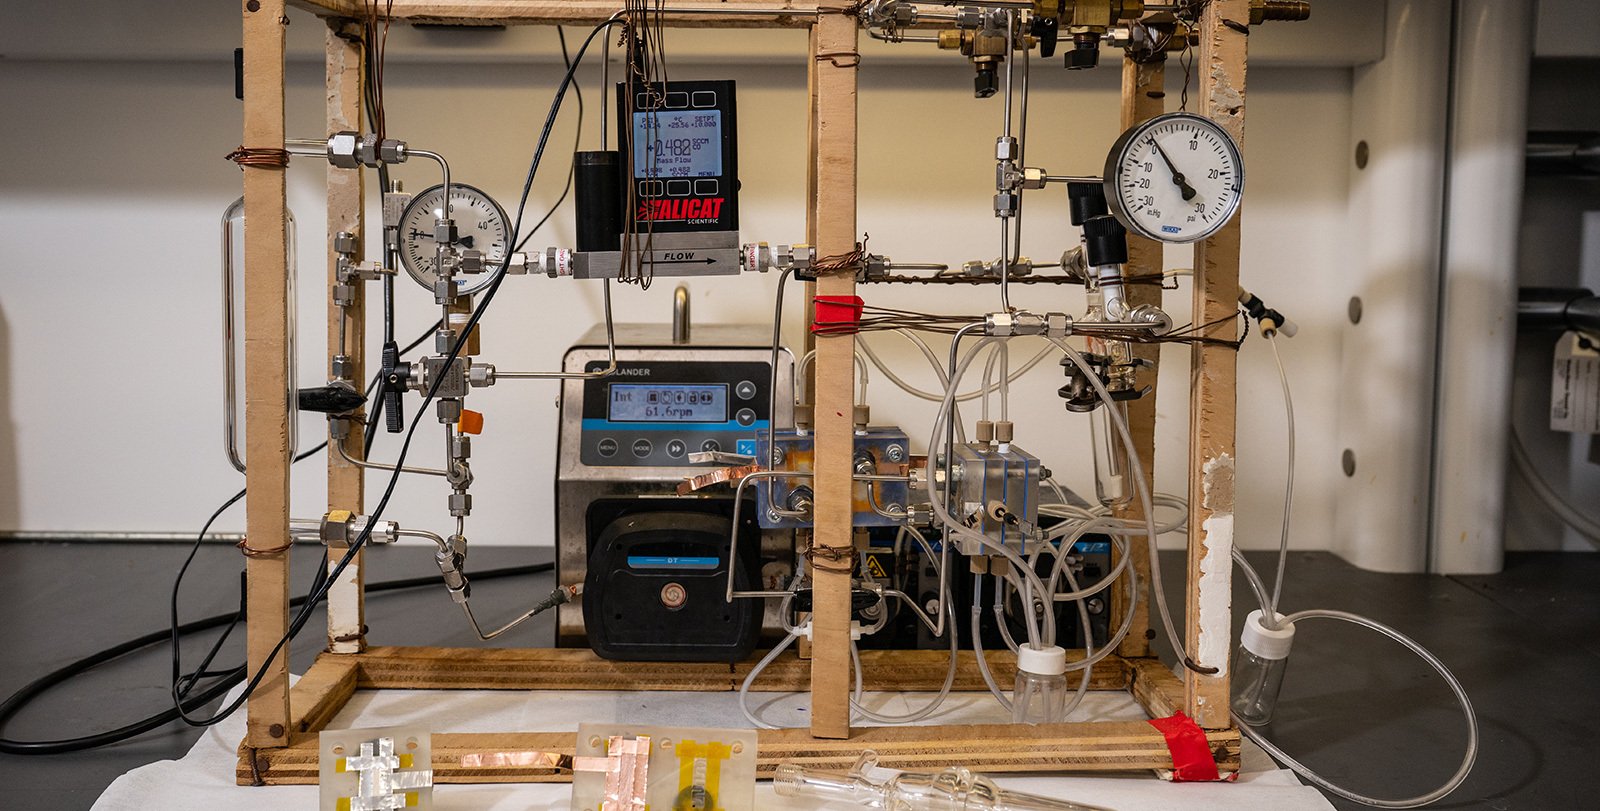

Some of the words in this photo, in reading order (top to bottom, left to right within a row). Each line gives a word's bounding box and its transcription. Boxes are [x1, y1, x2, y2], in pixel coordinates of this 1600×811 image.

[1189, 140, 1198, 151] 10
[1207, 168, 1218, 179] 20
[658, 198, 725, 220] ALICAT
[1194, 203, 1205, 213] 30
[1187, 214, 1197, 222] psi
[477, 221, 488, 230] 40
[664, 252, 695, 261] FLOW
[614, 391, 633, 402] Int
